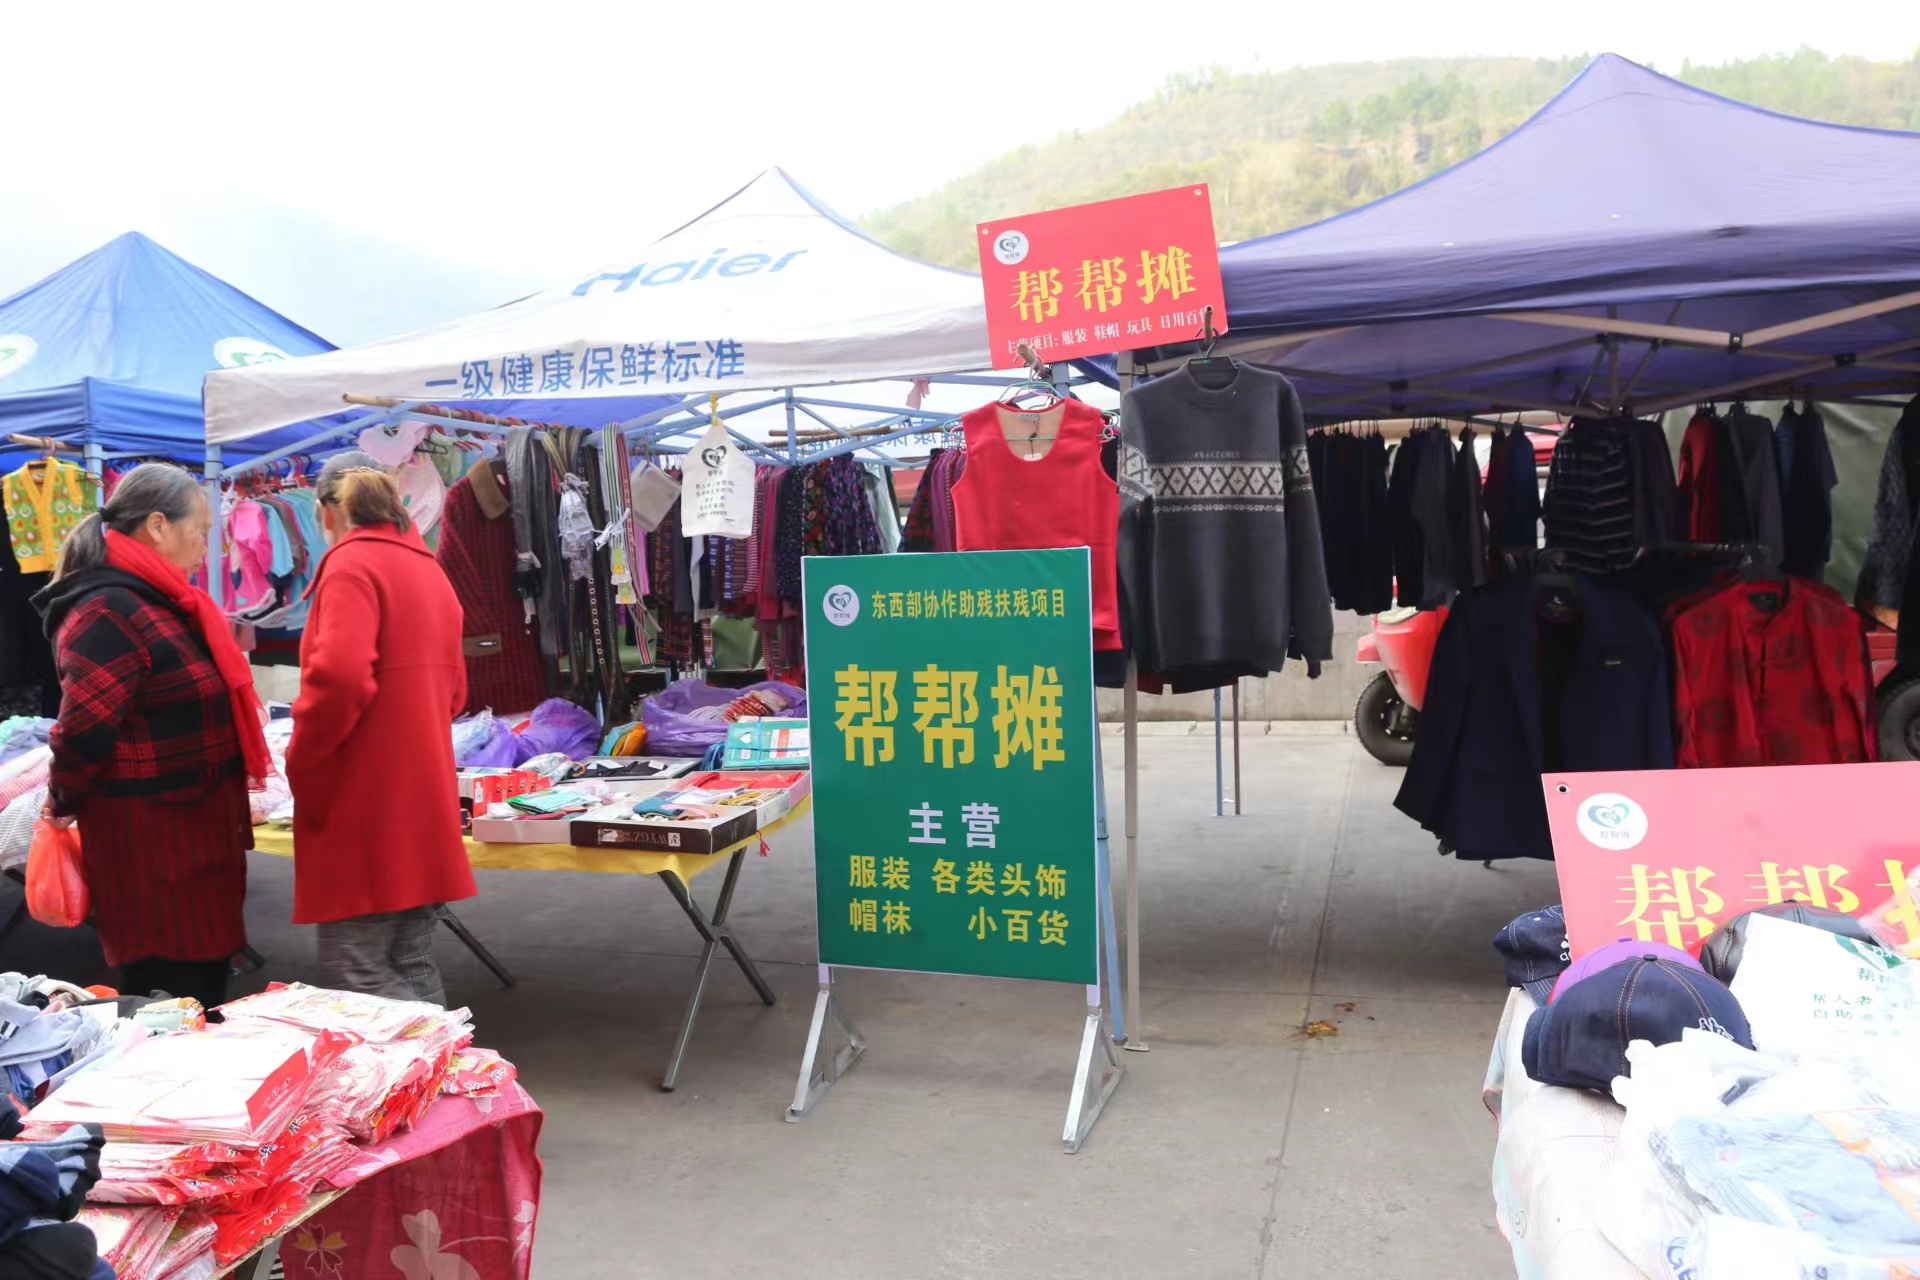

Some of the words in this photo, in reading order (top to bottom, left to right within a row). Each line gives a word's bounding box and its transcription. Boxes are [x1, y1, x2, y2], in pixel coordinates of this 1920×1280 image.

[571, 247, 809, 297] Haier
[1009, 245, 1198, 324] 帮帮摊
[1127, 316, 1153, 336] 玩具
[424, 338, 746, 400] 一级健康保鲜标准
[871, 588, 1066, 620] 东西部协作助残扶残项目
[833, 663, 1067, 771] 帮帮摊
[908, 801, 1001, 849] 主营
[848, 854, 912, 890] 服装
[931, 857, 1068, 900] 各类头饰
[848, 898, 913, 935] 帽袜
[967, 906, 1070, 947] 小百货
